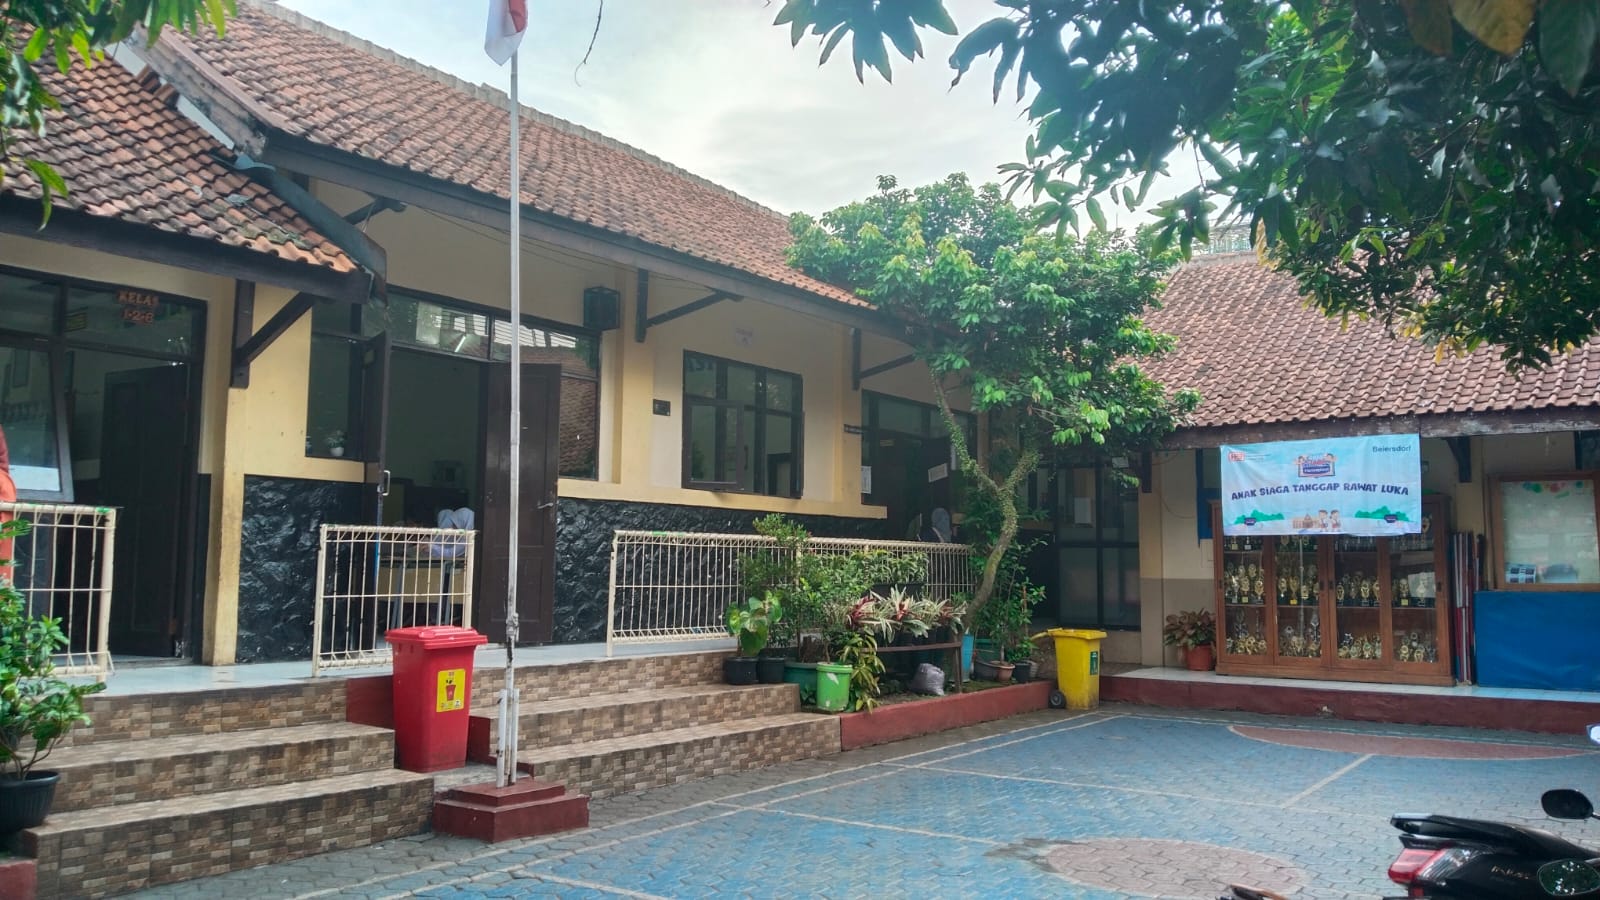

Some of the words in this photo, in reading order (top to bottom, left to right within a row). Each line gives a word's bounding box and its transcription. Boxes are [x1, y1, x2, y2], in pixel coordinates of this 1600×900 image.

[1372, 444, 1411, 453] Beiersdorf
[1231, 489, 1257, 500] ANAK
[1292, 483, 1340, 493] TANGGAP
[1343, 483, 1378, 492] RAWAT
[1381, 485, 1409, 496] LUKA
